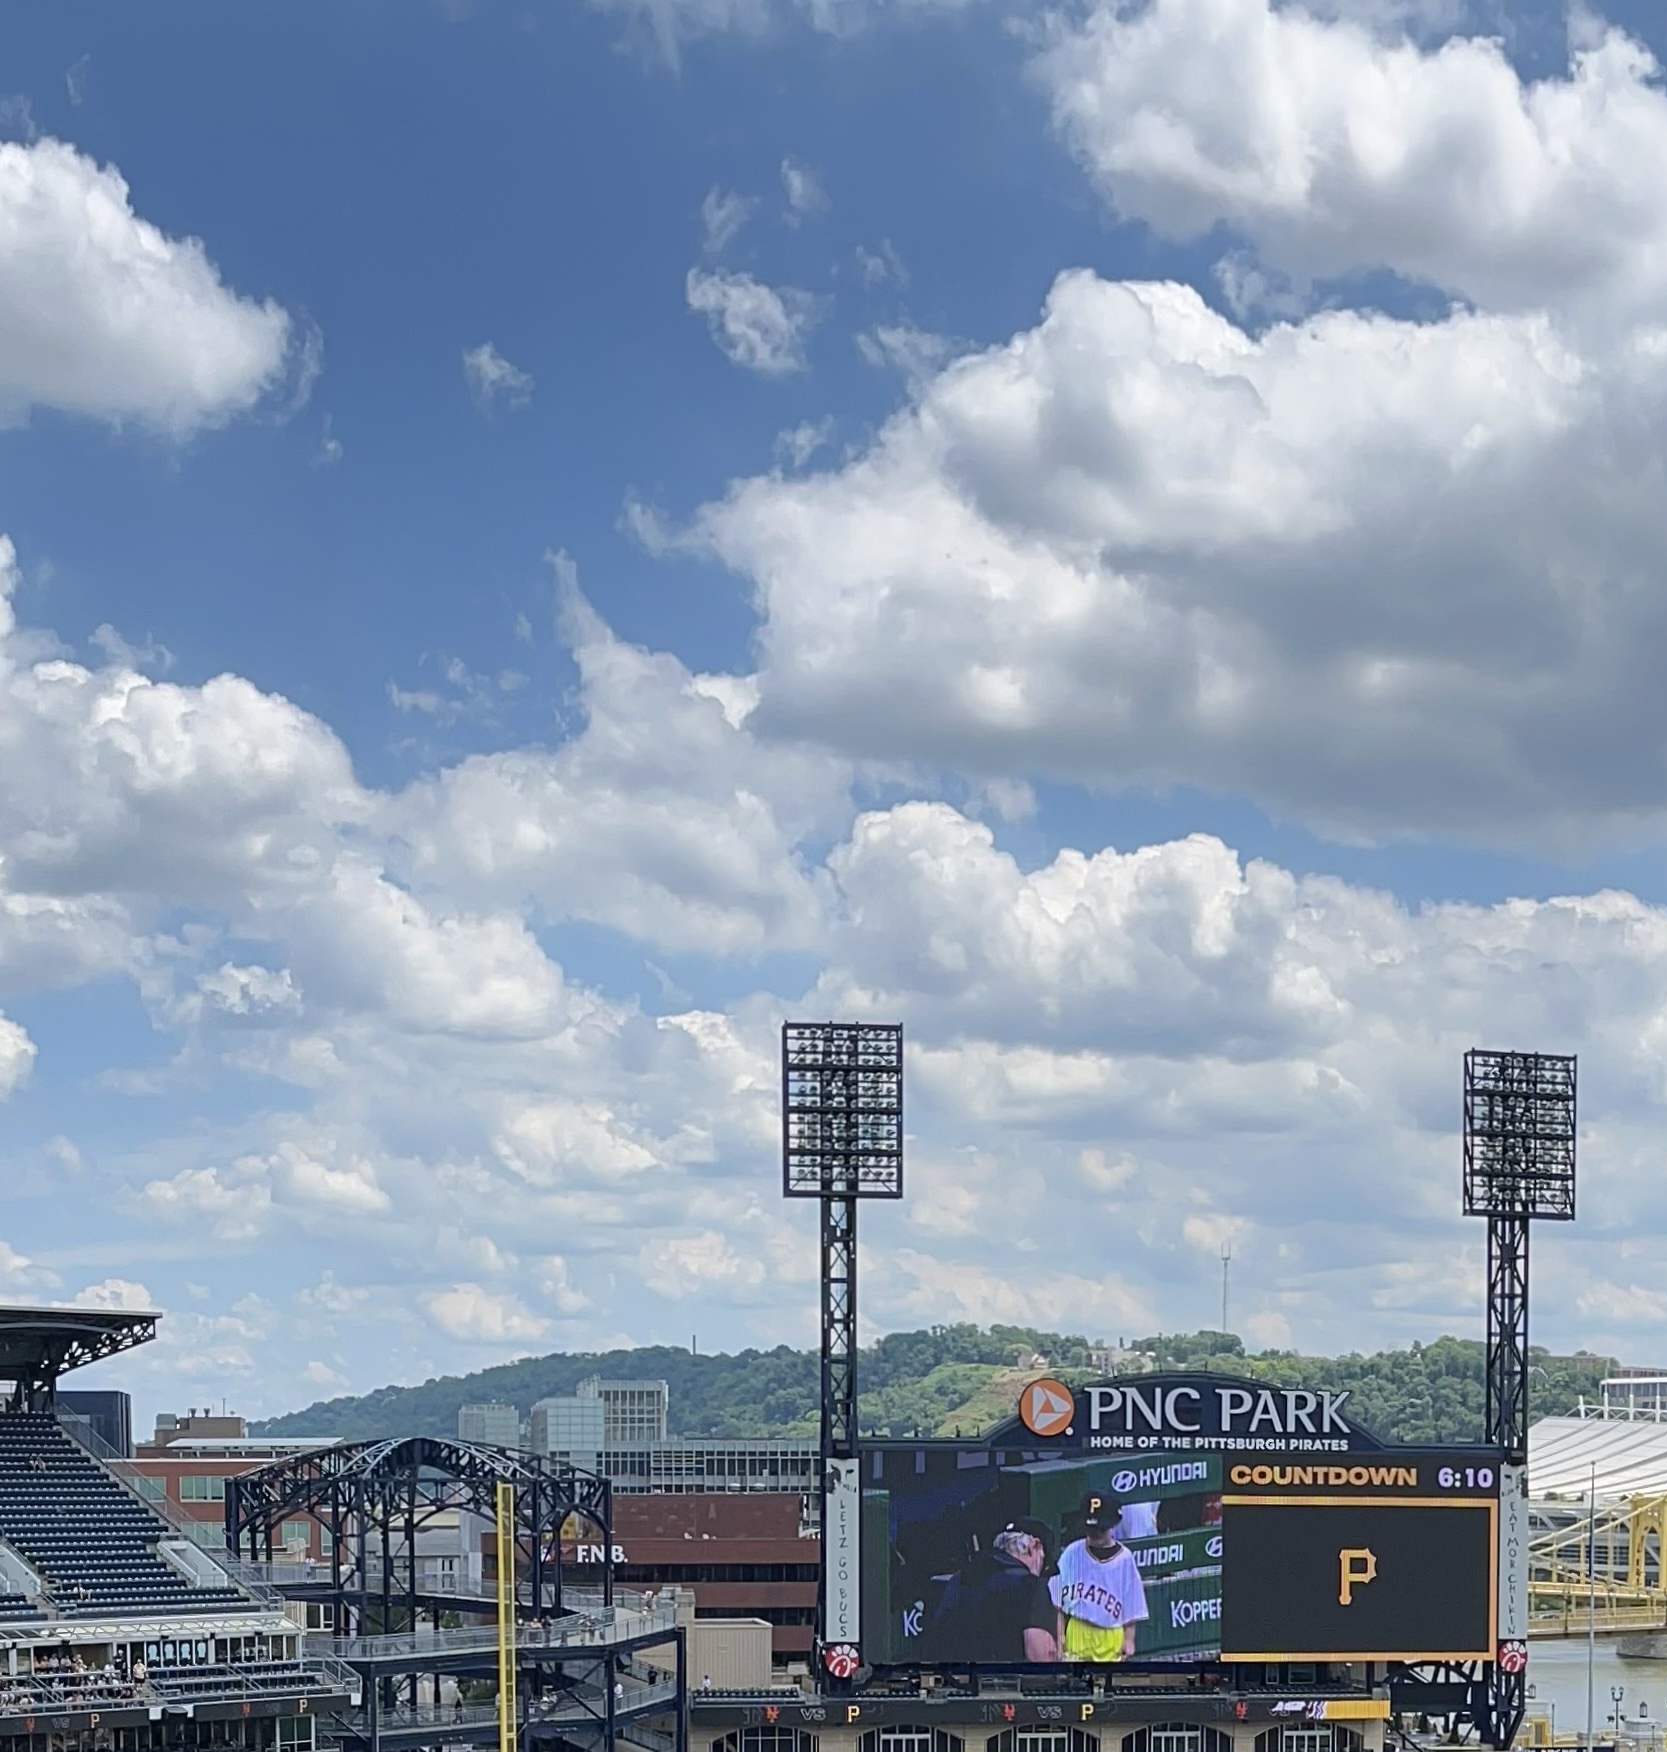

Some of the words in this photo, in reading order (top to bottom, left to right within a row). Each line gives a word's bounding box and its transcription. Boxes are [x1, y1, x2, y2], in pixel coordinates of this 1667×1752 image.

[1085, 1387, 1202, 1432] PNC
[1215, 1388, 1352, 1434] PARK
[1090, 1436, 1133, 1448] HOME
[1137, 1436, 1159, 1448] OF
[1162, 1437, 1192, 1449] THE
[1195, 1437, 1286, 1450] PITTSBURGH
[1289, 1438, 1349, 1451] PIRATES
[1140, 1461, 1208, 1488] HYUNDAI
[1230, 1465, 1417, 1487] COUNTDOWN
[1437, 1467, 1494, 1488] 6:10
[1090, 1498, 1102, 1513] P
[1508, 1502, 1517, 1528] EAT
[839, 1499, 848, 1549] LETZ
[1133, 1544, 1184, 1567] UNDAI
[1507, 1538, 1519, 1569] MOR
[839, 1557, 848, 1581] GO
[1338, 1548, 1377, 1606] P
[839, 1588, 848, 1637] BUCS
[1062, 1582, 1122, 1619] PIRATES
[1507, 1575, 1518, 1635] CHIKIN
[90, 1713, 101, 1729] P
[847, 1705, 861, 1723] P
[1081, 1703, 1095, 1721] P
